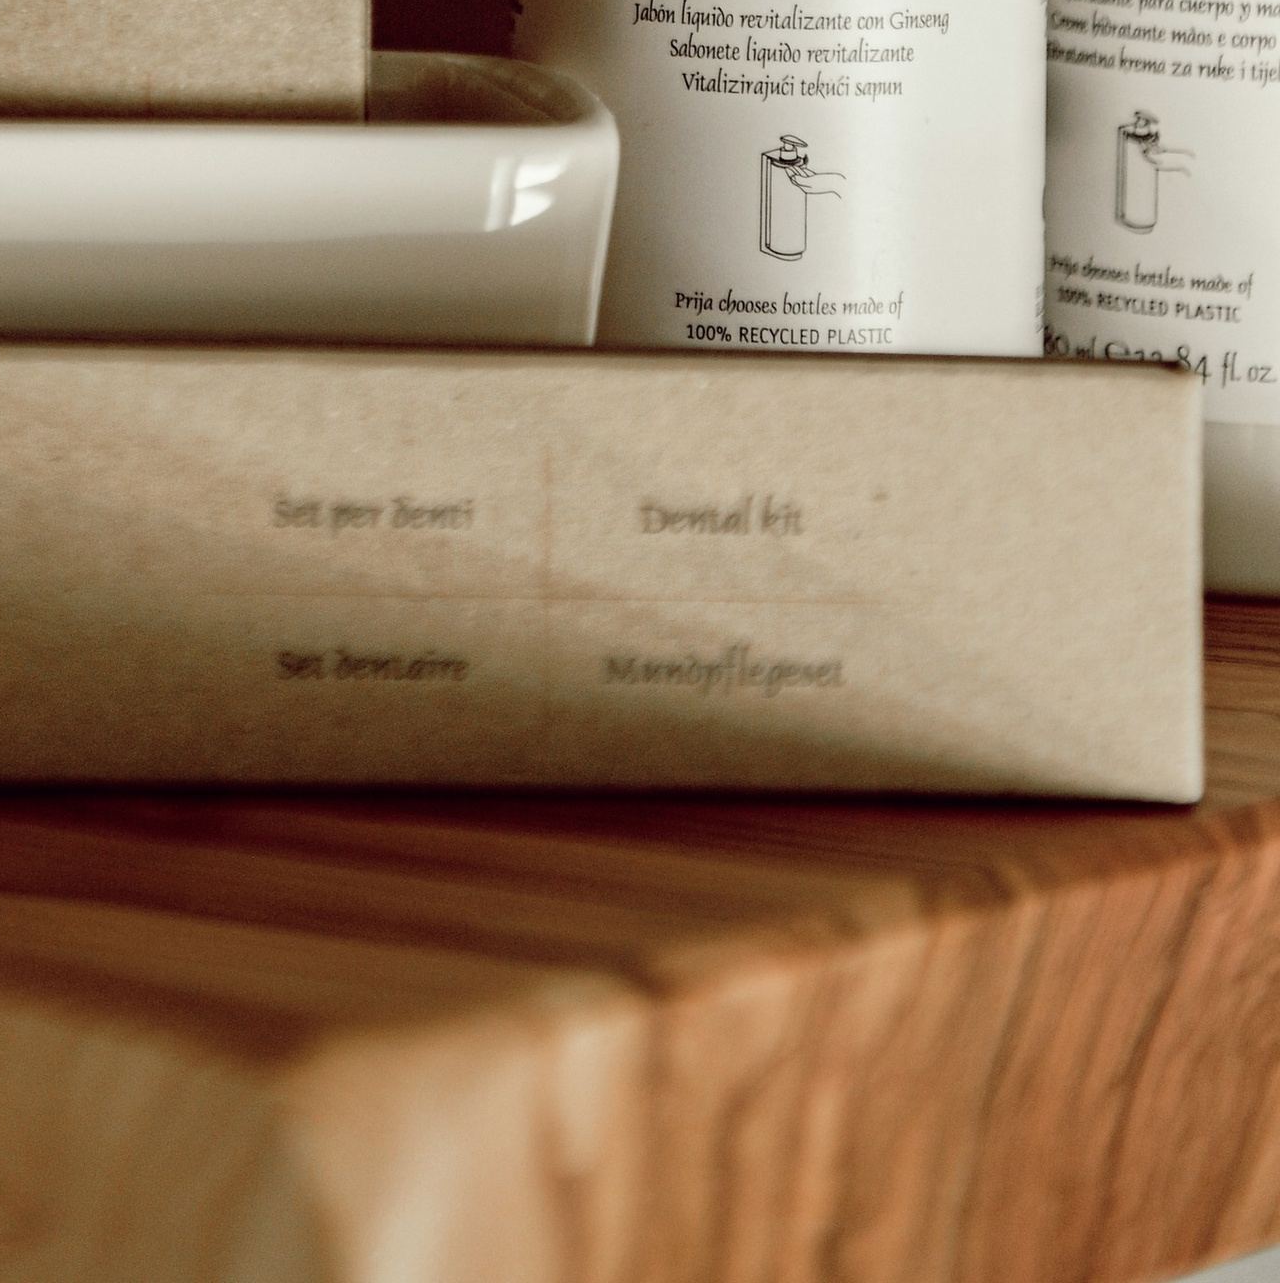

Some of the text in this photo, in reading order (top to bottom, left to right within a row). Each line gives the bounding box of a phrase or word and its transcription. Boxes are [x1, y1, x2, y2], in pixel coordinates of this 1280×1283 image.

[740, 4, 853, 32] revitalizante
[856, 13, 885, 31] con
[889, 9, 950, 35] Ginseng
[1238, 2, 1252, 24] y
[669, 33, 915, 68] Sabonete liquido revitalizante
[1091, 10, 1167, 43] hidratante
[1171, 25, 1214, 47] mãos
[1217, 33, 1227, 47] e
[1231, 34, 1277, 57] corpo
[1119, 45, 1166, 76] krema
[1171, 62, 1193, 78] za
[1198, 54, 1236, 82] ruke
[1240, 60, 1247, 81] i
[681, 67, 903, 103] Vitalizirajući tekući sapun
[1134, 262, 1186, 290] bottles
[1190, 275, 1234, 295] made
[1237, 271, 1255, 301] of
[675, 288, 905, 320] Prija chooses bottles made of
[1096, 292, 1170, 318] RECYCLED
[1174, 301, 1243, 325] PLASTIC
[686, 323, 893, 346] 100% RECYCLED PLASTIC
[1044, 324, 1070, 357] 80
[1247, 364, 1278, 384] oz
[639, 494, 754, 534] Dental
